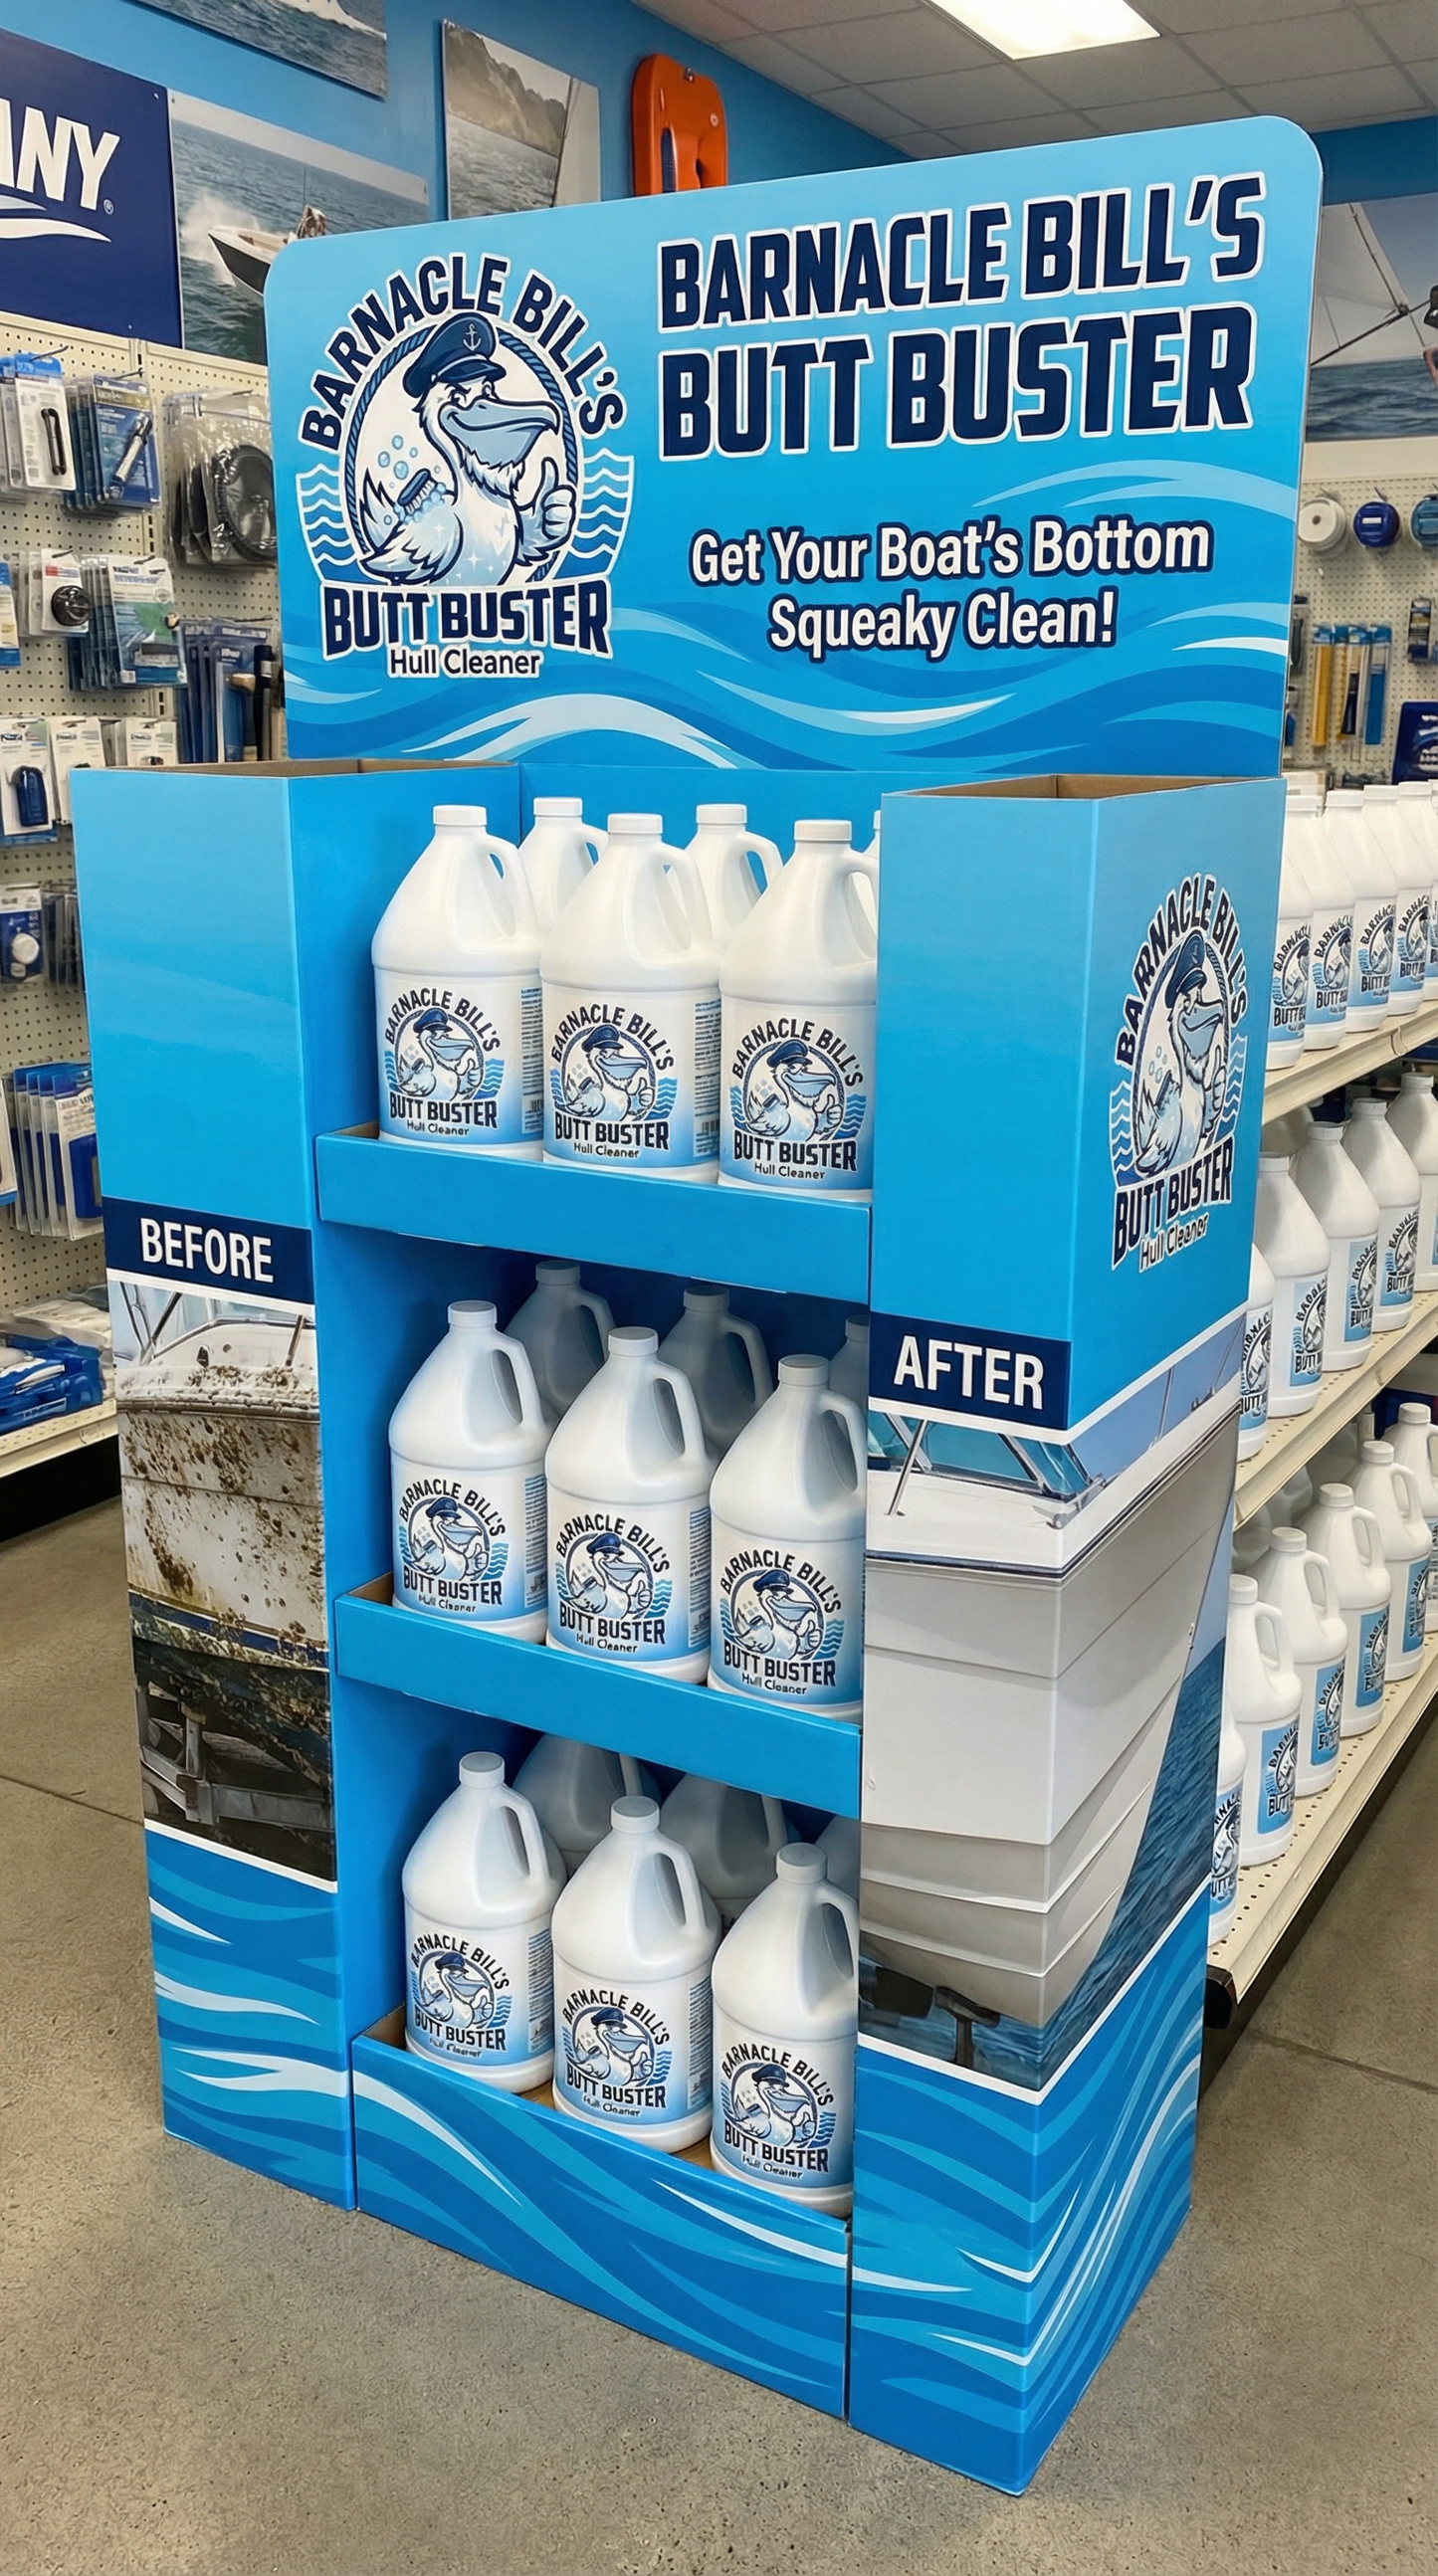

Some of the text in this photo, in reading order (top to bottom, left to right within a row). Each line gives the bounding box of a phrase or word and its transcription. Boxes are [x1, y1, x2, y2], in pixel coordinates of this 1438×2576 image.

[659, 175, 1264, 329] BARNACLE BILL'S
[302, 255, 624, 451] BARNACLE BILL'S
[660, 304, 1256, 459] BUTT BUSTER
[692, 520, 1210, 581] Get Your Boat's Bottom
[323, 580, 610, 657] BUTT BUSTER
[770, 591, 1116, 659] Squeaky Clean!
[390, 650, 539, 675] Hull Cleaner
[1116, 876, 1246, 1067] BARNACLE BILL'S
[385, 987, 453, 1045] BARNACLE
[454, 997, 501, 1052] BILL'S
[551, 1003, 625, 1064] BARNACLE
[629, 1013, 675, 1071] BILL'S
[731, 1017, 815, 1081] BARNACLE
[816, 1028, 864, 1088] BILL'S
[389, 1091, 427, 1119] BUTT
[427, 1099, 498, 1129] BUSTER
[554, 1110, 592, 1140] BUTT
[595, 1120, 669, 1150] BUSTER
[573, 1142, 594, 1155] Hull
[733, 1129, 775, 1161] BUTT
[778, 1140, 857, 1172] BUSTER
[754, 1163, 826, 1180] Hull Cleaner
[1113, 1135, 1233, 1267] BUTT BUSTER
[140, 1217, 274, 1284] BEFORE
[1140, 1233, 1164, 1270] Hull
[894, 1334, 1045, 1411] AFTER
[399, 1478, 462, 1523] BARNACLE
[464, 1489, 507, 1537] BILL'S
[555, 1513, 626, 1558] BARNACLE
[627, 1524, 670, 1573] BILL'S
[403, 1565, 435, 1594] BUTT
[438, 1580, 503, 1605] BUSTER
[719, 1549, 796, 1596] BARNACLE
[796, 1562, 842, 1614] BILL'S
[559, 1602, 666, 1645] BUTT BUSTER
[724, 1640, 837, 1687] BUTT BUSTER
[471, 1947, 510, 1990] BILL'S
[414, 2006, 443, 2038] BUTT
[446, 2026, 507, 2052] BUSTER
[630, 2001, 671, 2046] BILL'S
[566, 2062, 599, 2096] BUTT
[602, 2085, 667, 2108] BUSTER
[721, 2043, 835, 2106] BARNACLE BILL'S
[724, 2121, 830, 2173] BUTT BUSTER
